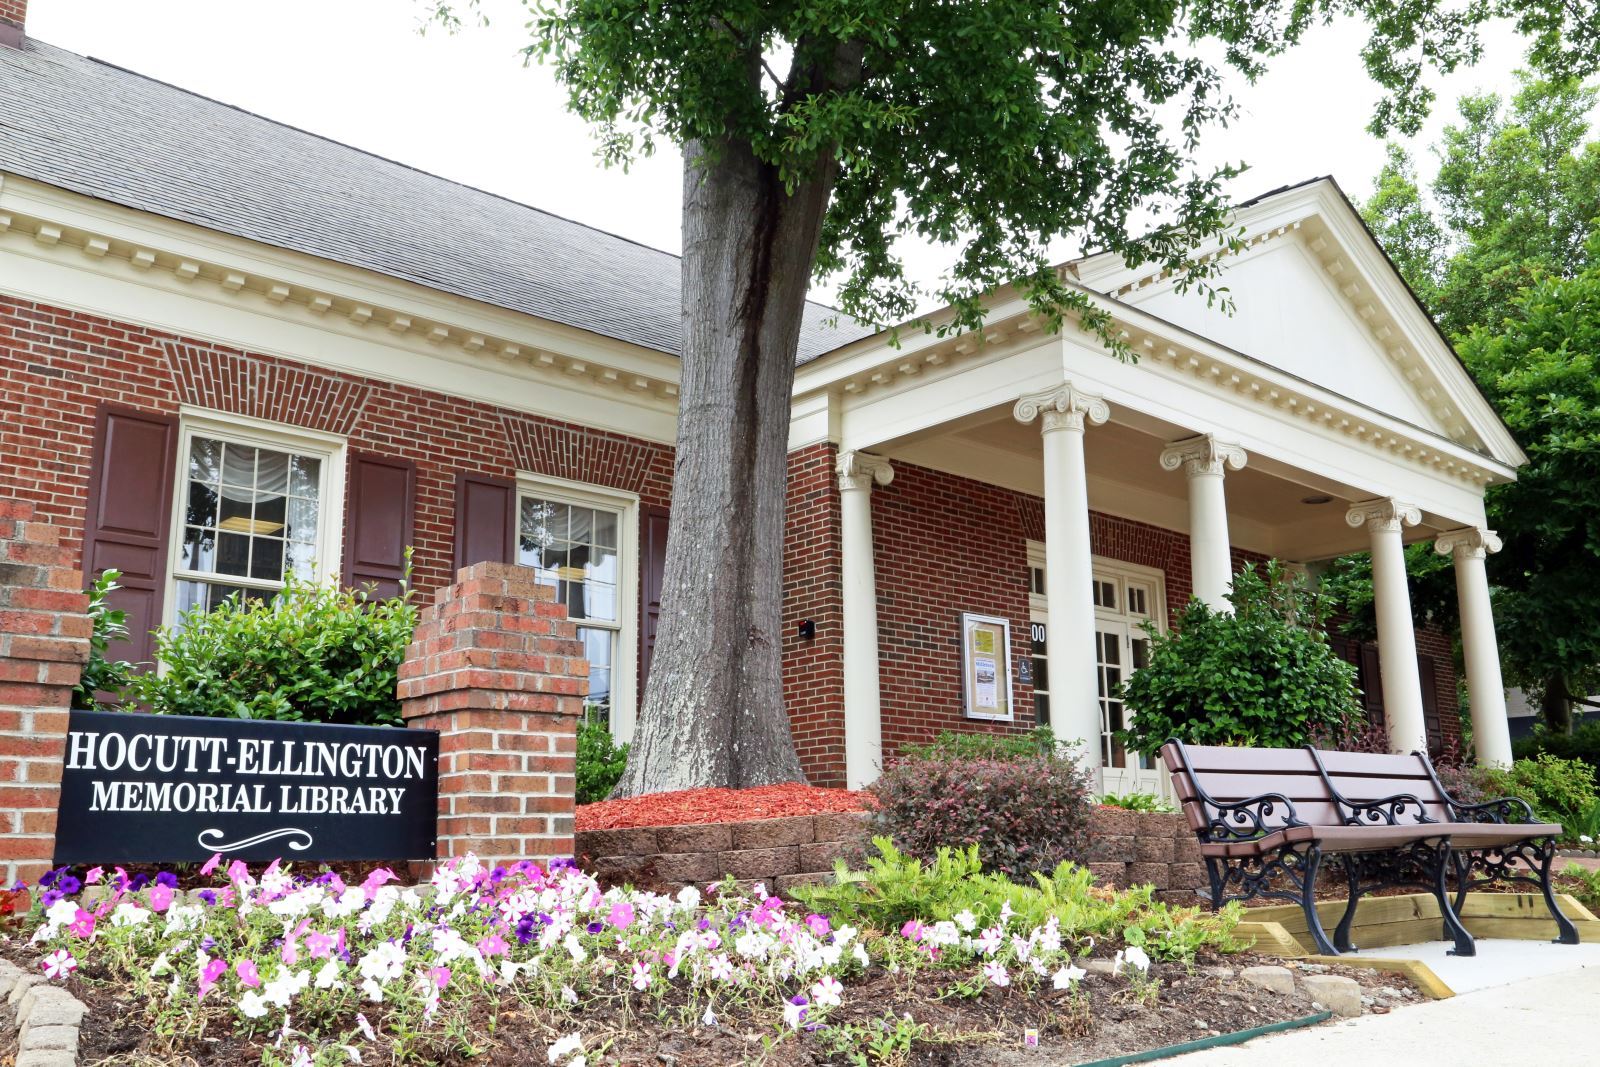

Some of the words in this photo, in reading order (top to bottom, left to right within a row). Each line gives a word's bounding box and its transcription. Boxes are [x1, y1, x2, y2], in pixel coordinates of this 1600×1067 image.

[65, 731, 427, 780] HOCUTT-ELLINGTON
[88, 780, 272, 813] MEMORIAL
[278, 785, 406, 815] LIBRARY
